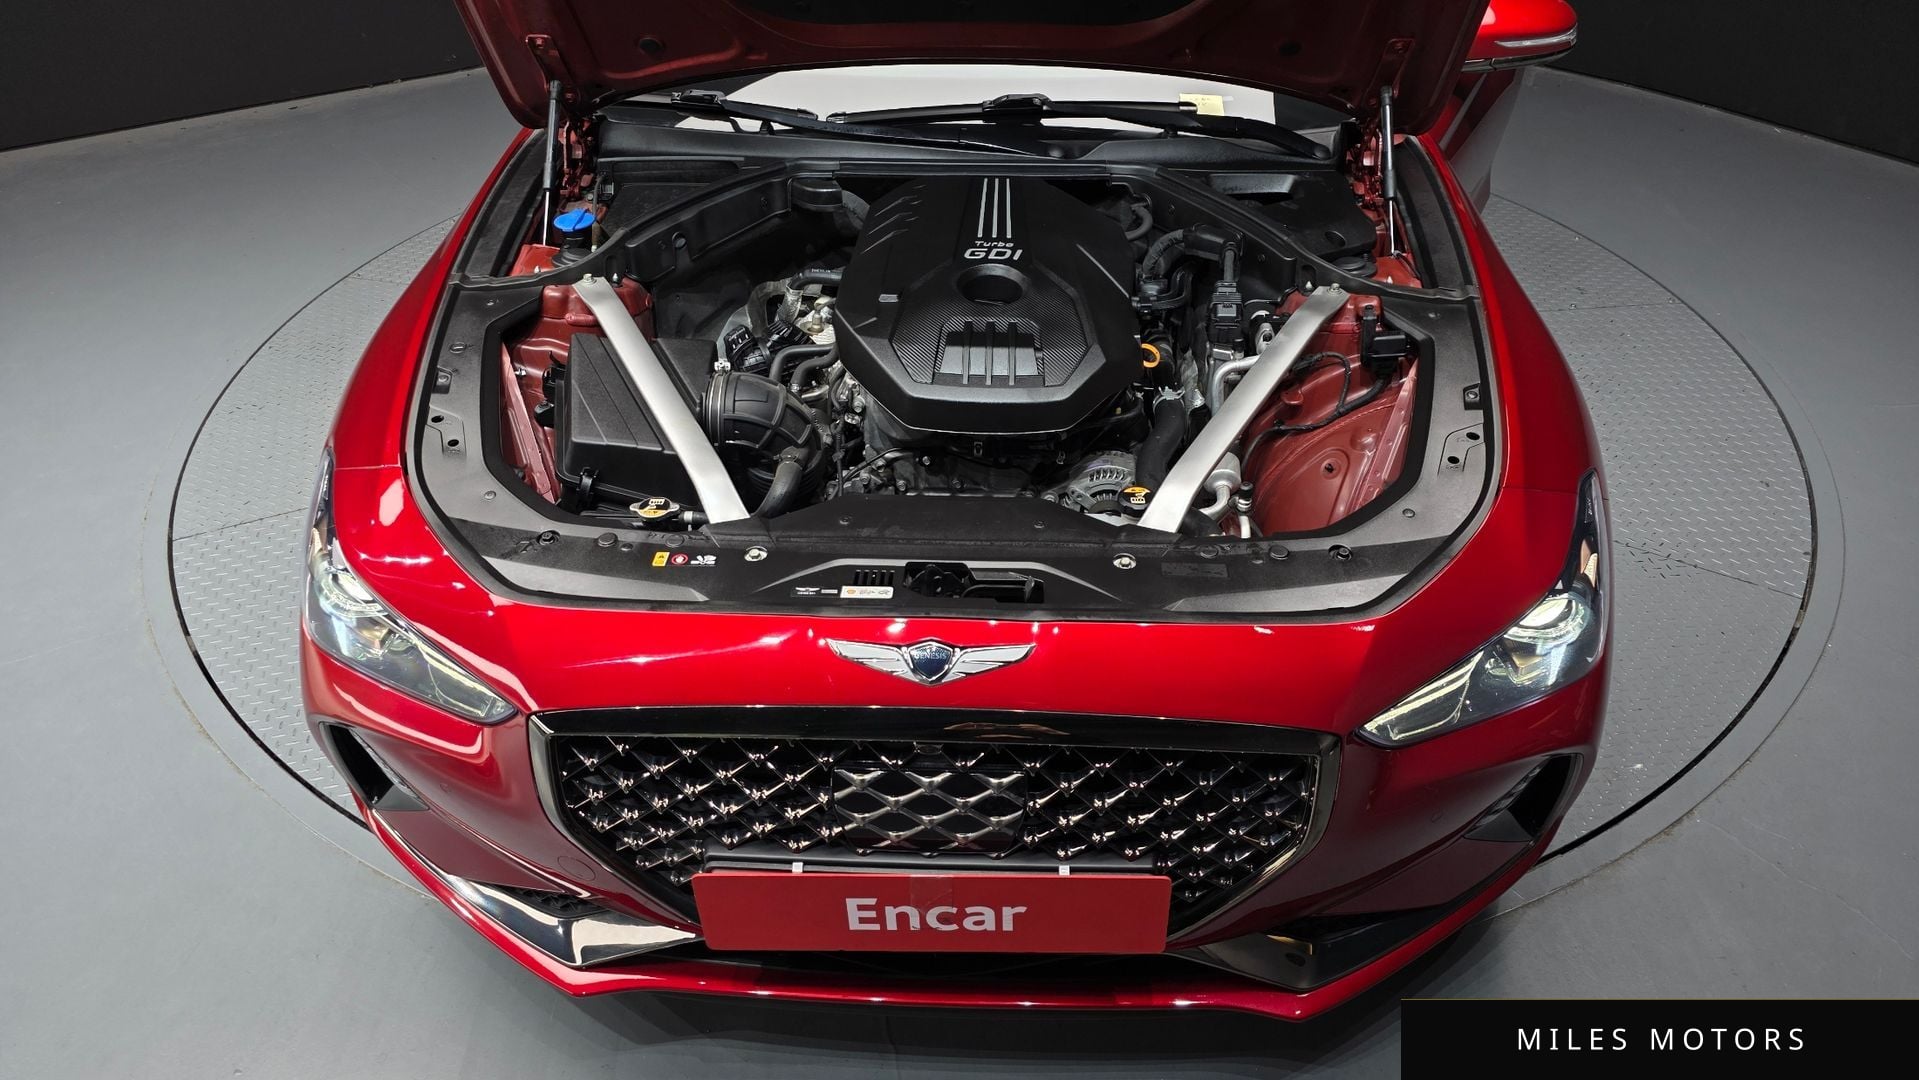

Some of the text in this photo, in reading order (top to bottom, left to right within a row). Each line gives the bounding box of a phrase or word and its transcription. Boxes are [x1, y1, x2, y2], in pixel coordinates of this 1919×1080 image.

[975, 240, 1014, 248] Turbo
[964, 248, 1023, 260] GDI
[914, 650, 947, 660] GENESIS
[845, 897, 1028, 932] Encar
